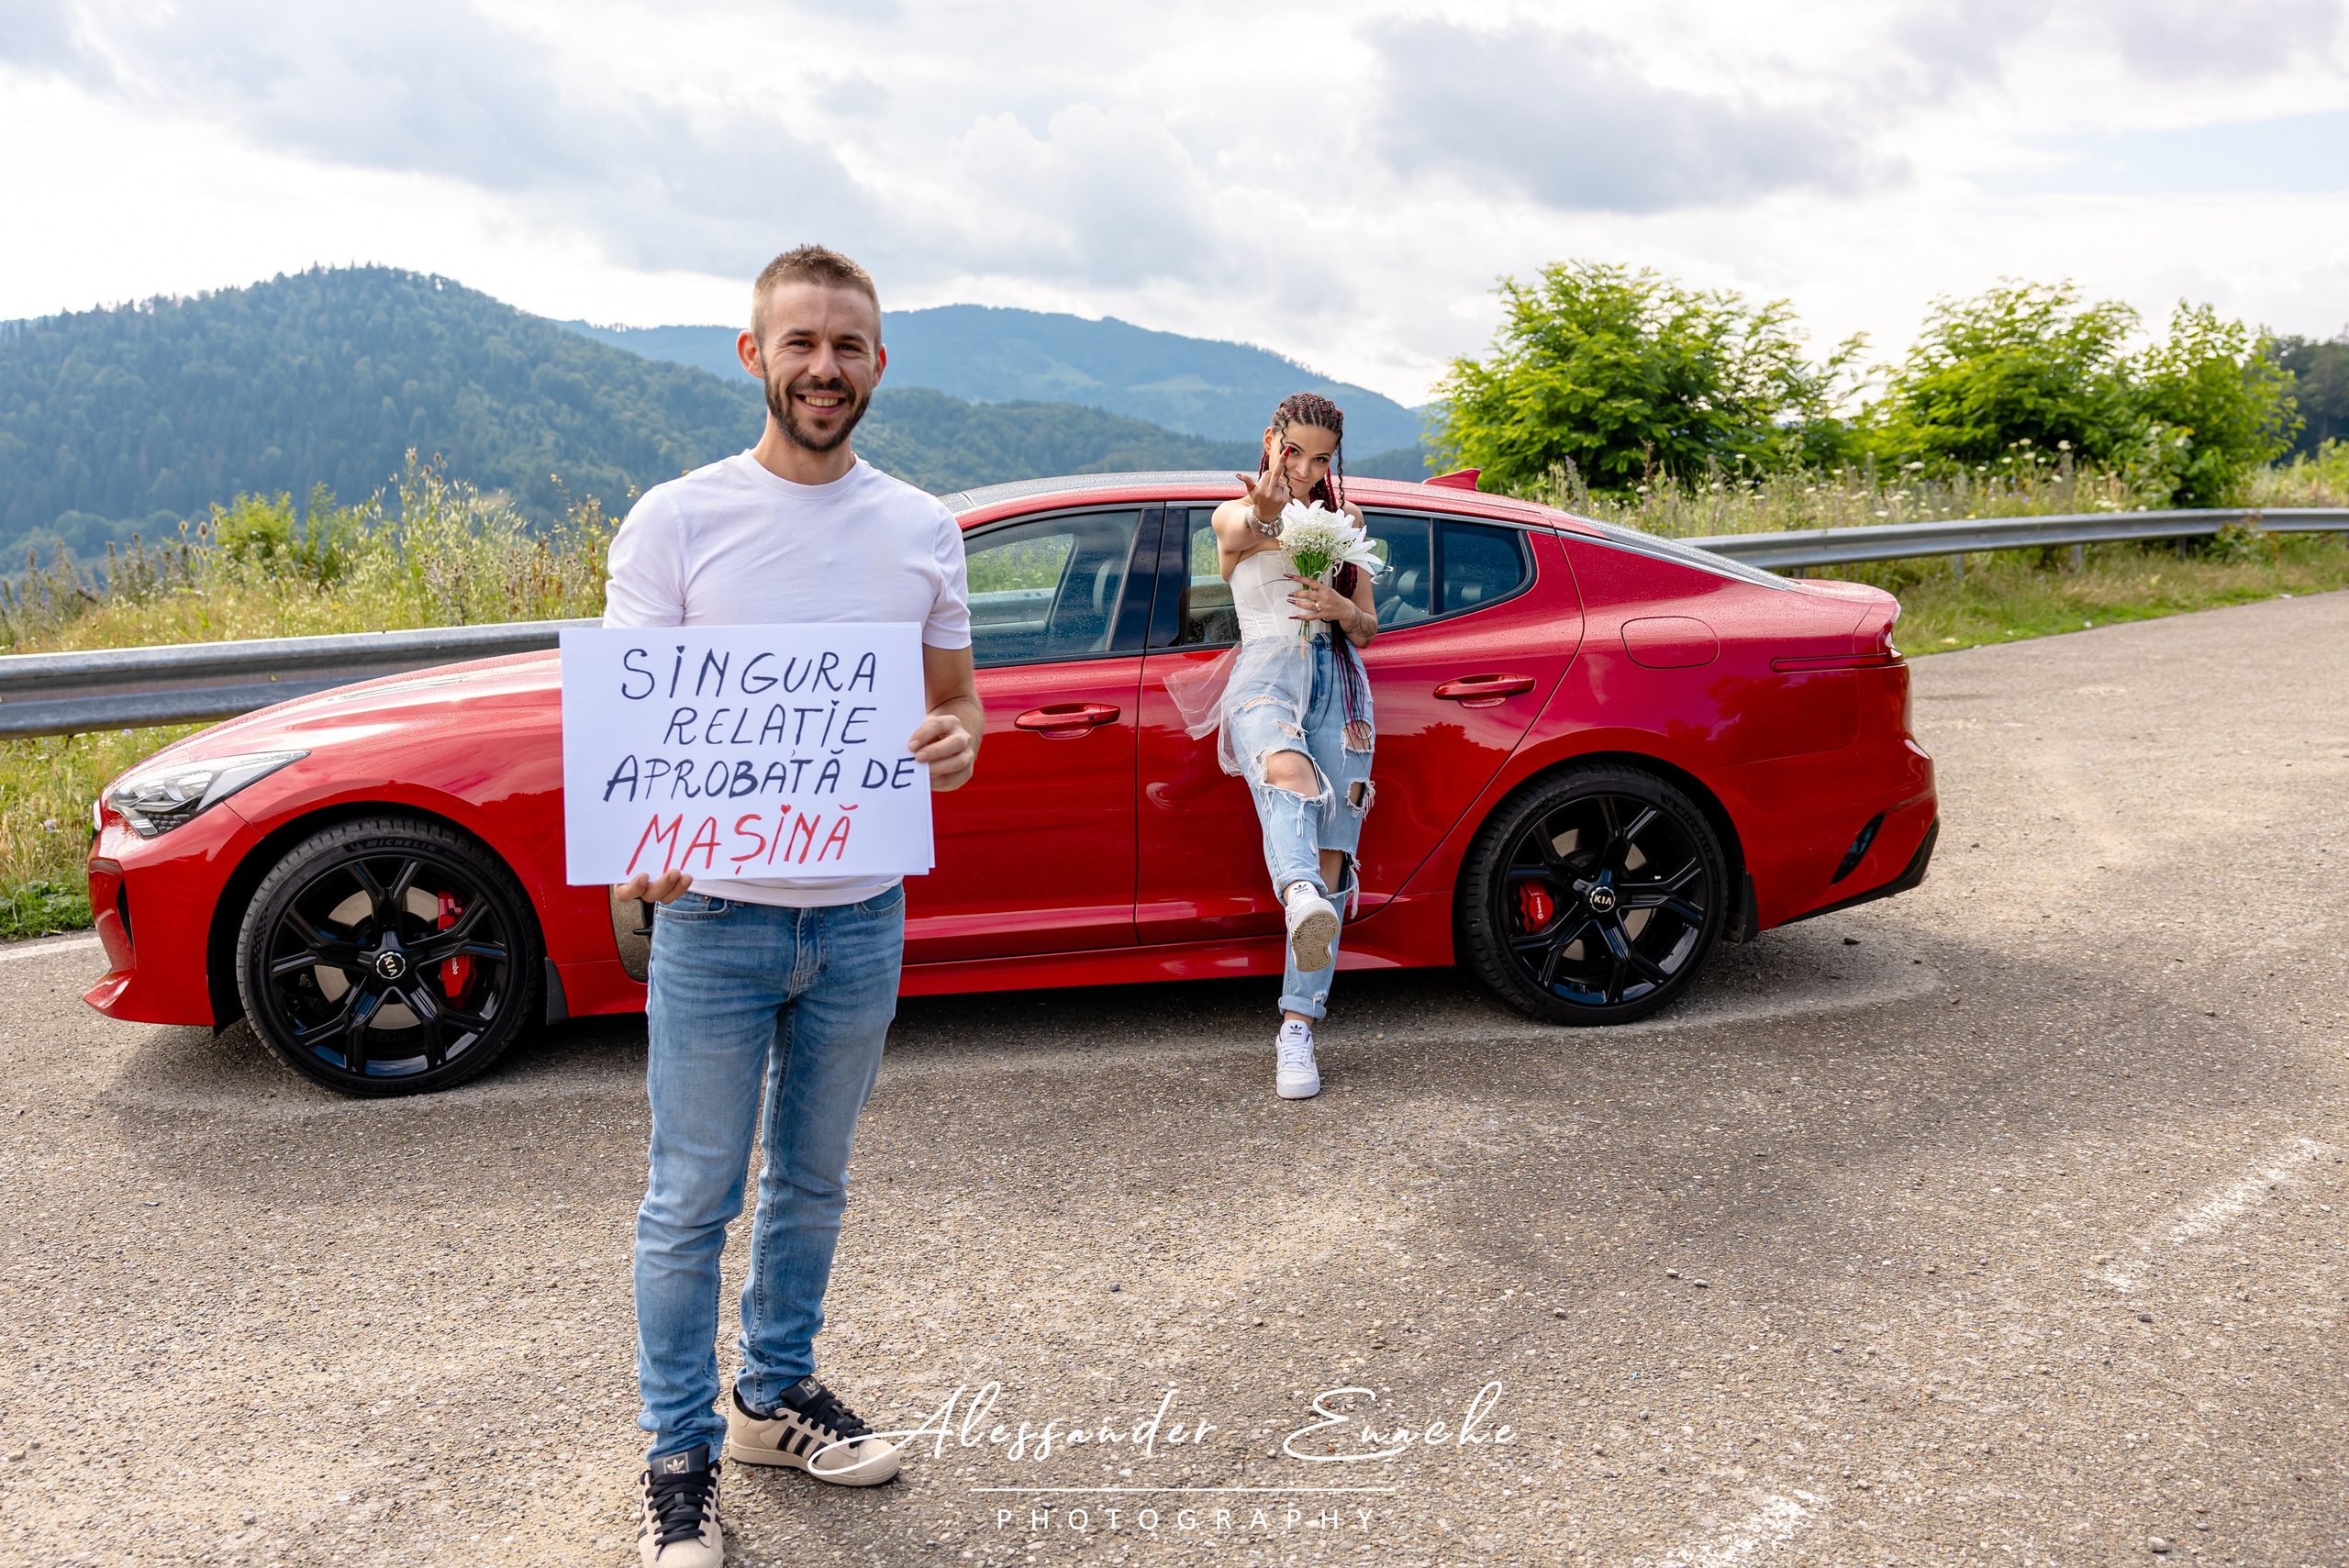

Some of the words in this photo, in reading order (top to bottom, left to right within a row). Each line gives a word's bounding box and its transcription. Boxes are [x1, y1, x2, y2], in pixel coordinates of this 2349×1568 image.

[621, 645, 876, 700] SINGURA
[602, 748, 845, 803] APROBATĂ
[860, 756, 917, 790] DE
[365, 838, 438, 853] MICHELIN
[625, 804, 859, 876] MAȘINĂ
[1593, 895, 1612, 906] KIA
[384, 955, 398, 976] KIA
